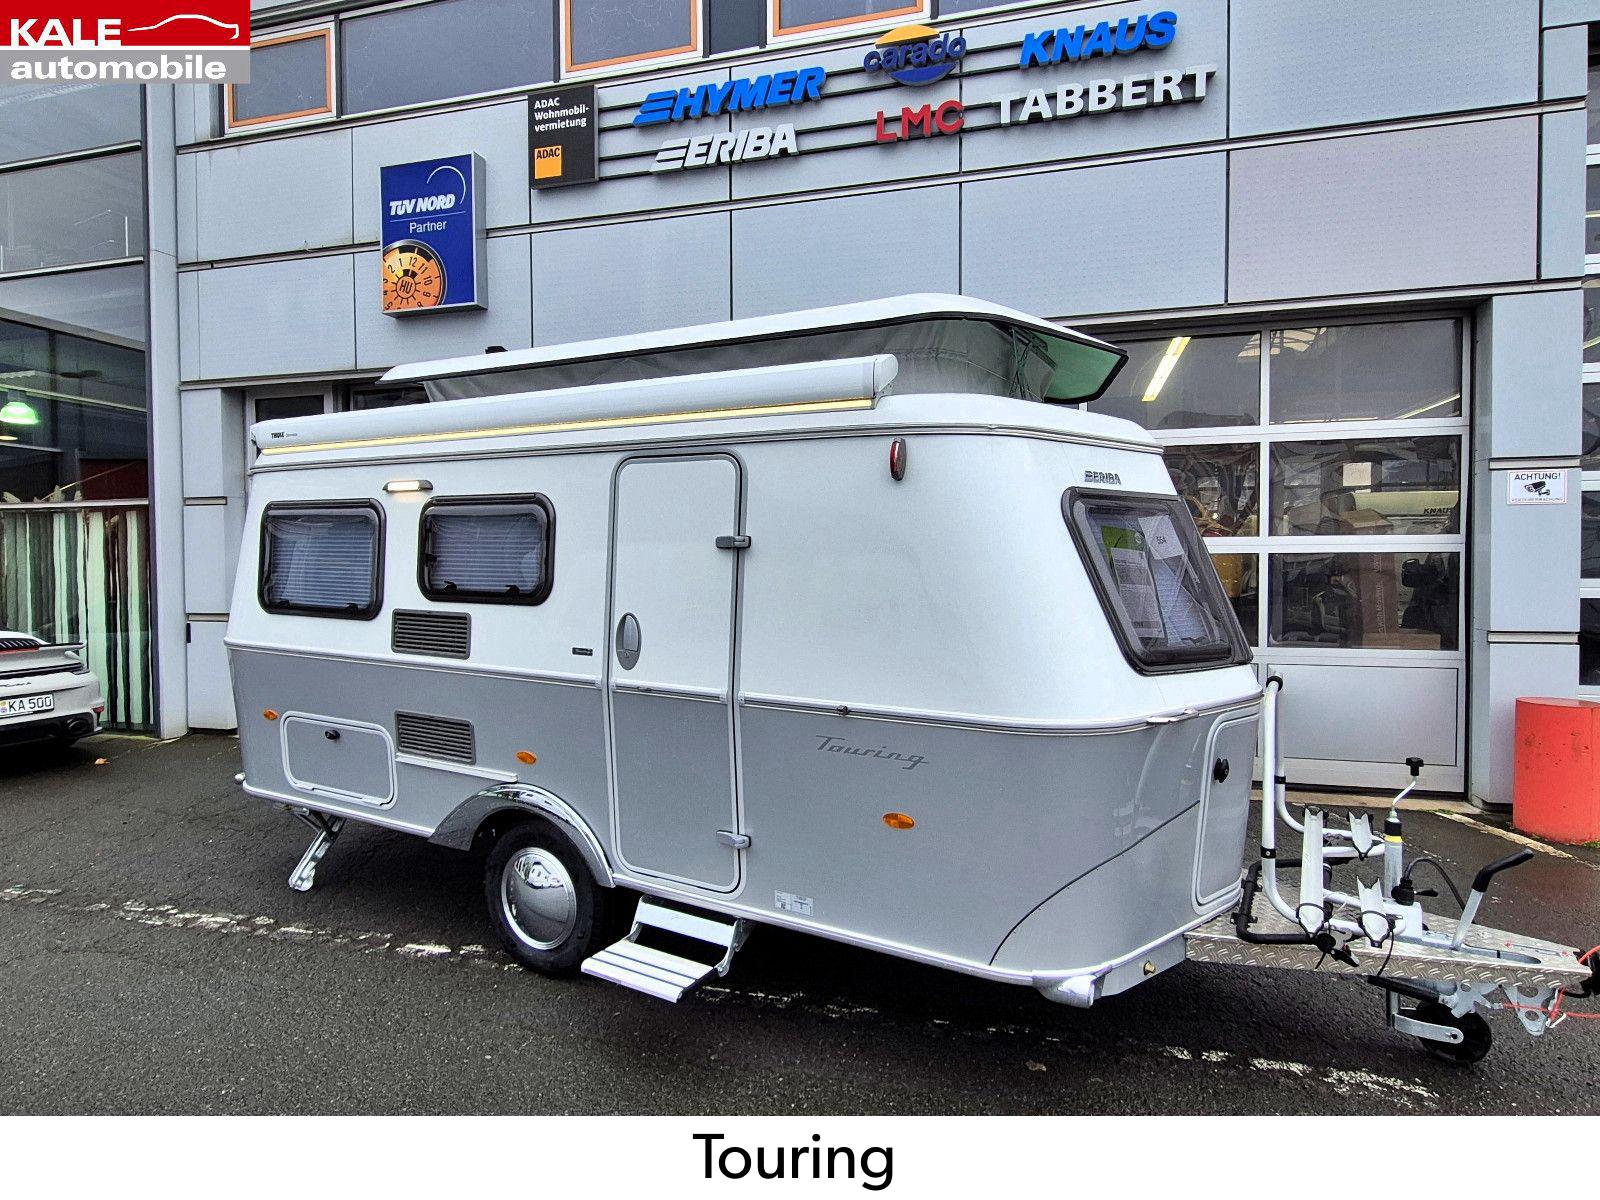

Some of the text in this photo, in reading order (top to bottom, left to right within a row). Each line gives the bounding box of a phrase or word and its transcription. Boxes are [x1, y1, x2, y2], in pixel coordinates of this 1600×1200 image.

[1019, 11, 1178, 69] KNAUS
[863, 33, 967, 74] carado
[671, 66, 827, 121] HYMER
[991, 64, 1218, 127] TABBERT
[534, 97, 560, 109] ADAC
[534, 104, 589, 120] Wohnmobil-
[534, 117, 587, 132] vermietung
[876, 99, 965, 143] LMC
[536, 147, 560, 160] ADAC
[684, 123, 799, 169] ERIBA
[389, 193, 456, 215] TÜV NORD
[409, 221, 447, 234] Partner
[409, 256, 418, 267] 12
[399, 280, 412, 294] HU
[1514, 472, 1561, 480] ACHTUNG!
[8, 696, 52, 712] KA 500
[816, 735, 930, 770] Touring
